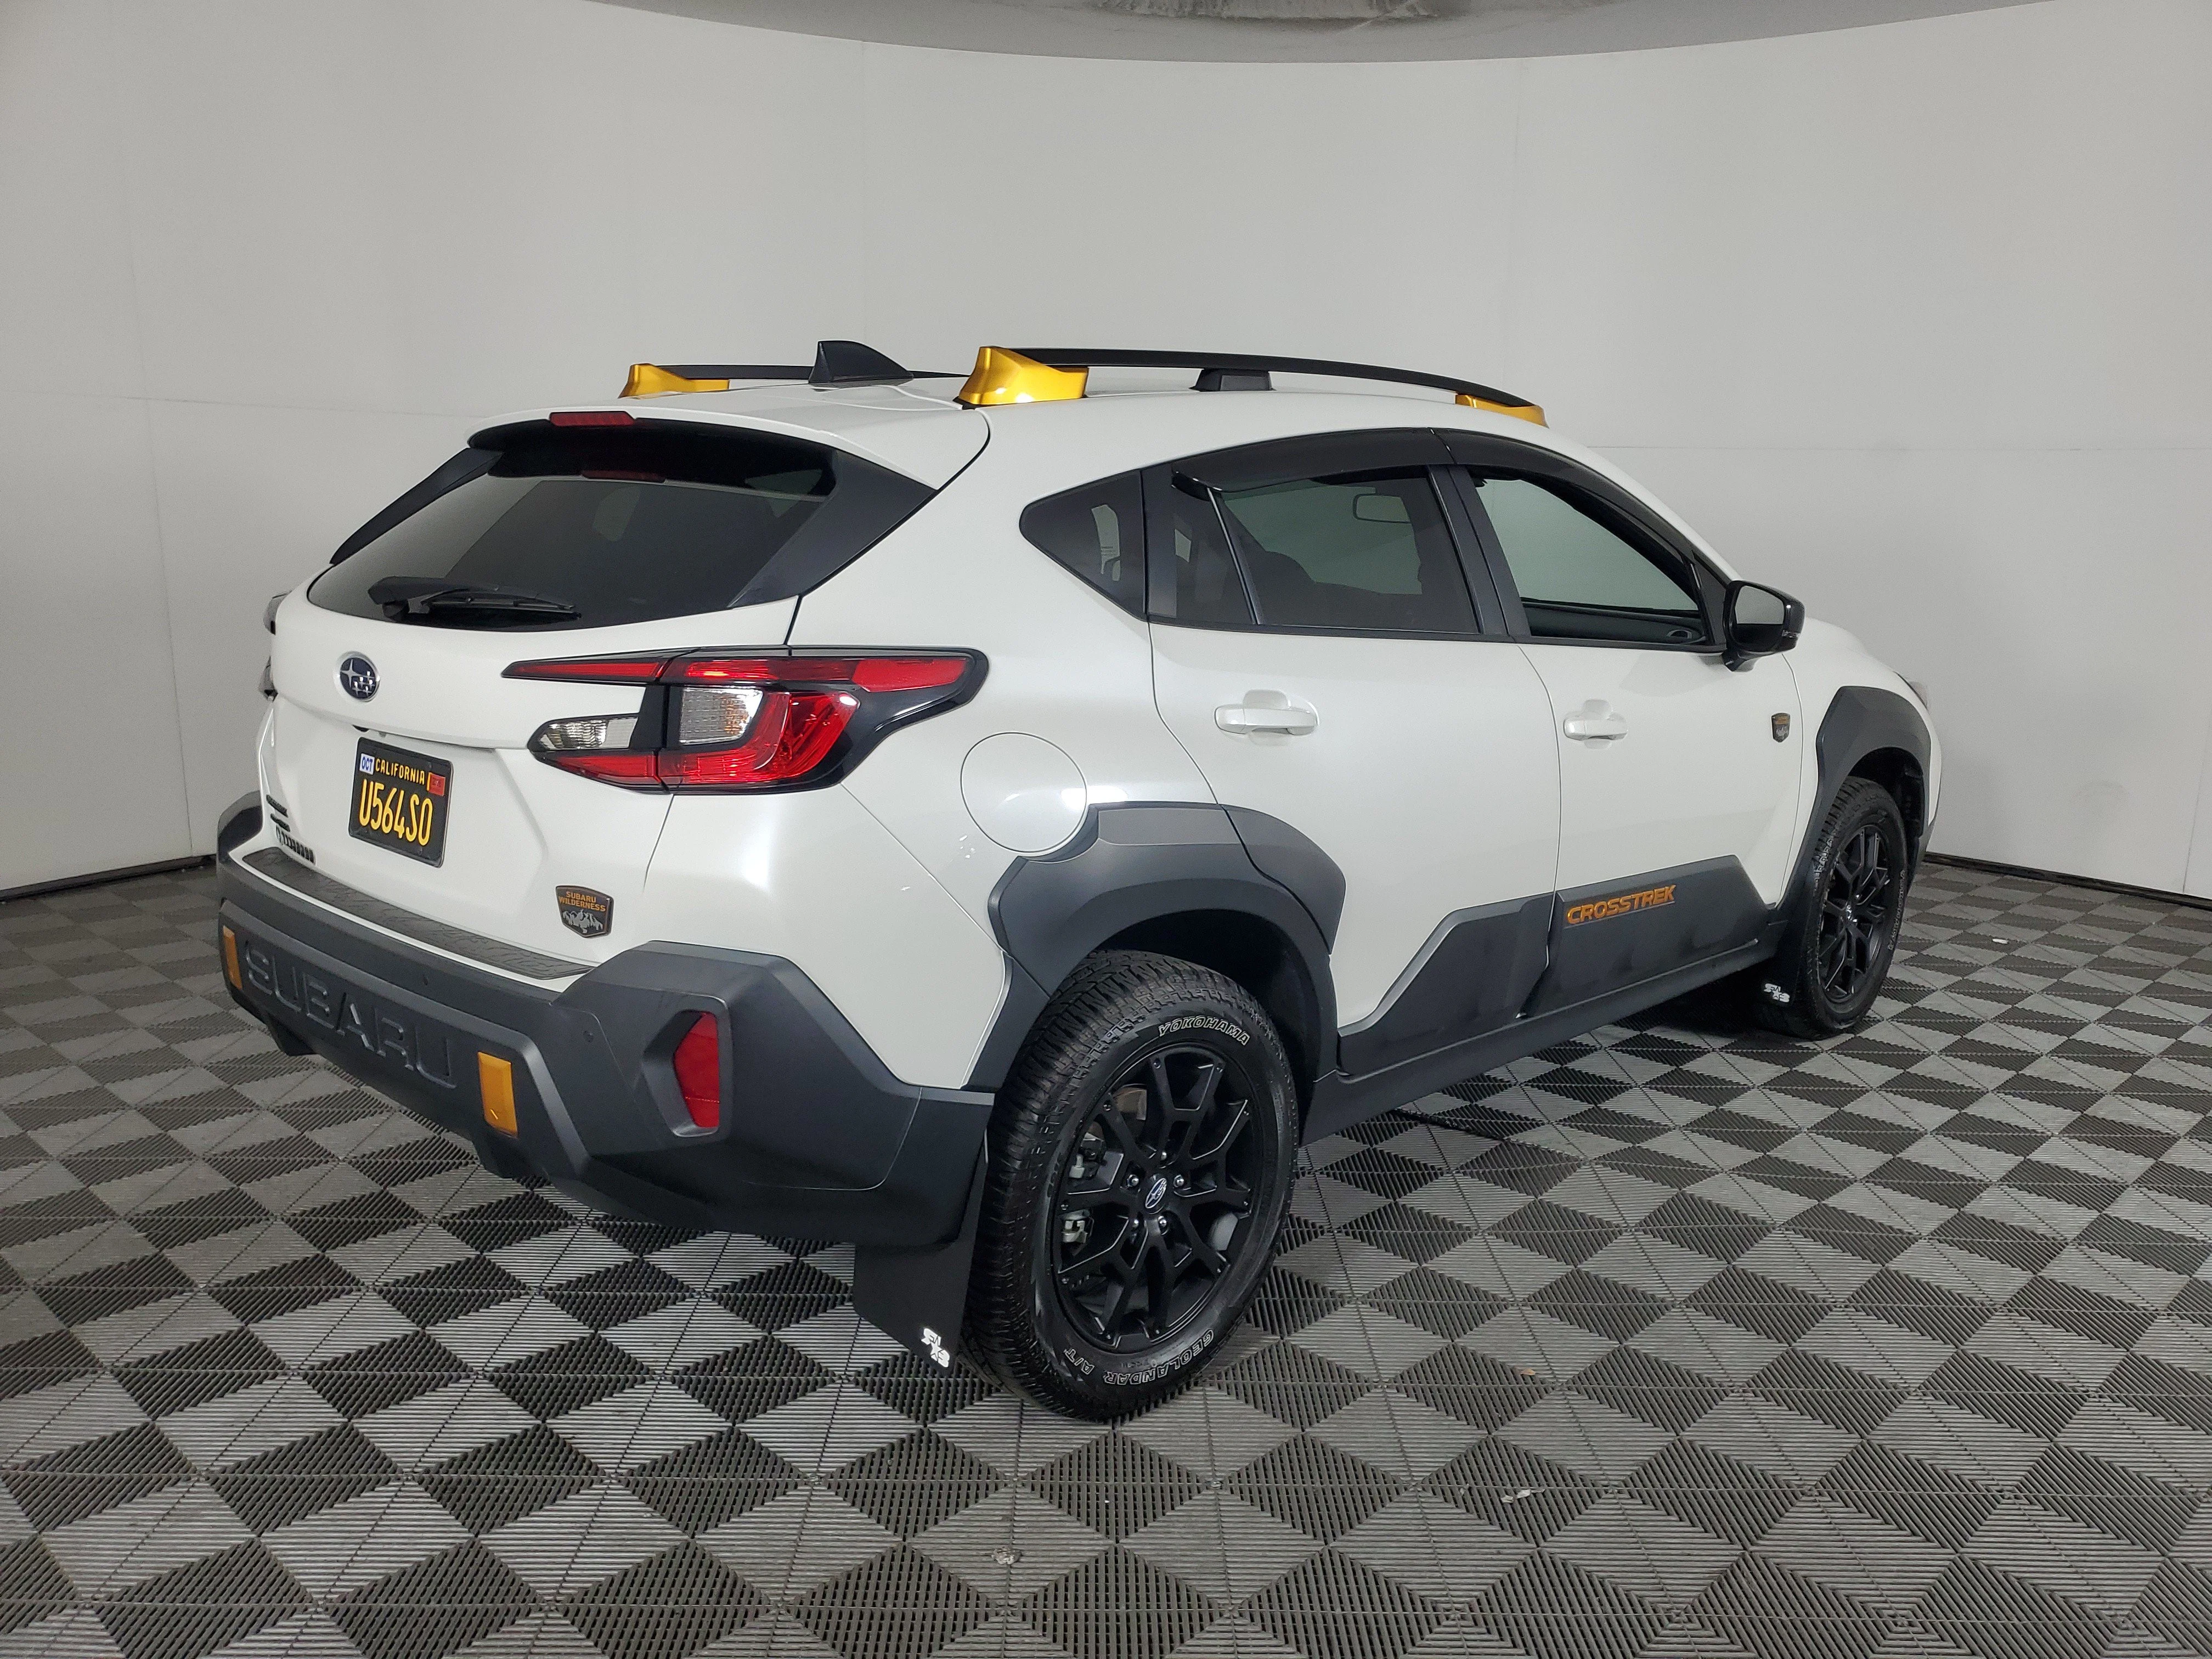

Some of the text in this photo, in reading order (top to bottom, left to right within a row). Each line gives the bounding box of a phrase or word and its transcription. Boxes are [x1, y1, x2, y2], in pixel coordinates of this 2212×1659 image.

[362, 756, 373, 772] OCT
[375, 758, 425, 785] CALIFORNIA
[558, 896, 606, 912] WILDERNESS
[566, 891, 596, 903] SUBARU
[1567, 884, 1677, 924] CROSSTREK
[245, 940, 456, 1089] SUBARU
[1158, 1015, 1251, 1046] YOKOHAMA
[1063, 1329, 1214, 1385] GEOLANDAR A/T
